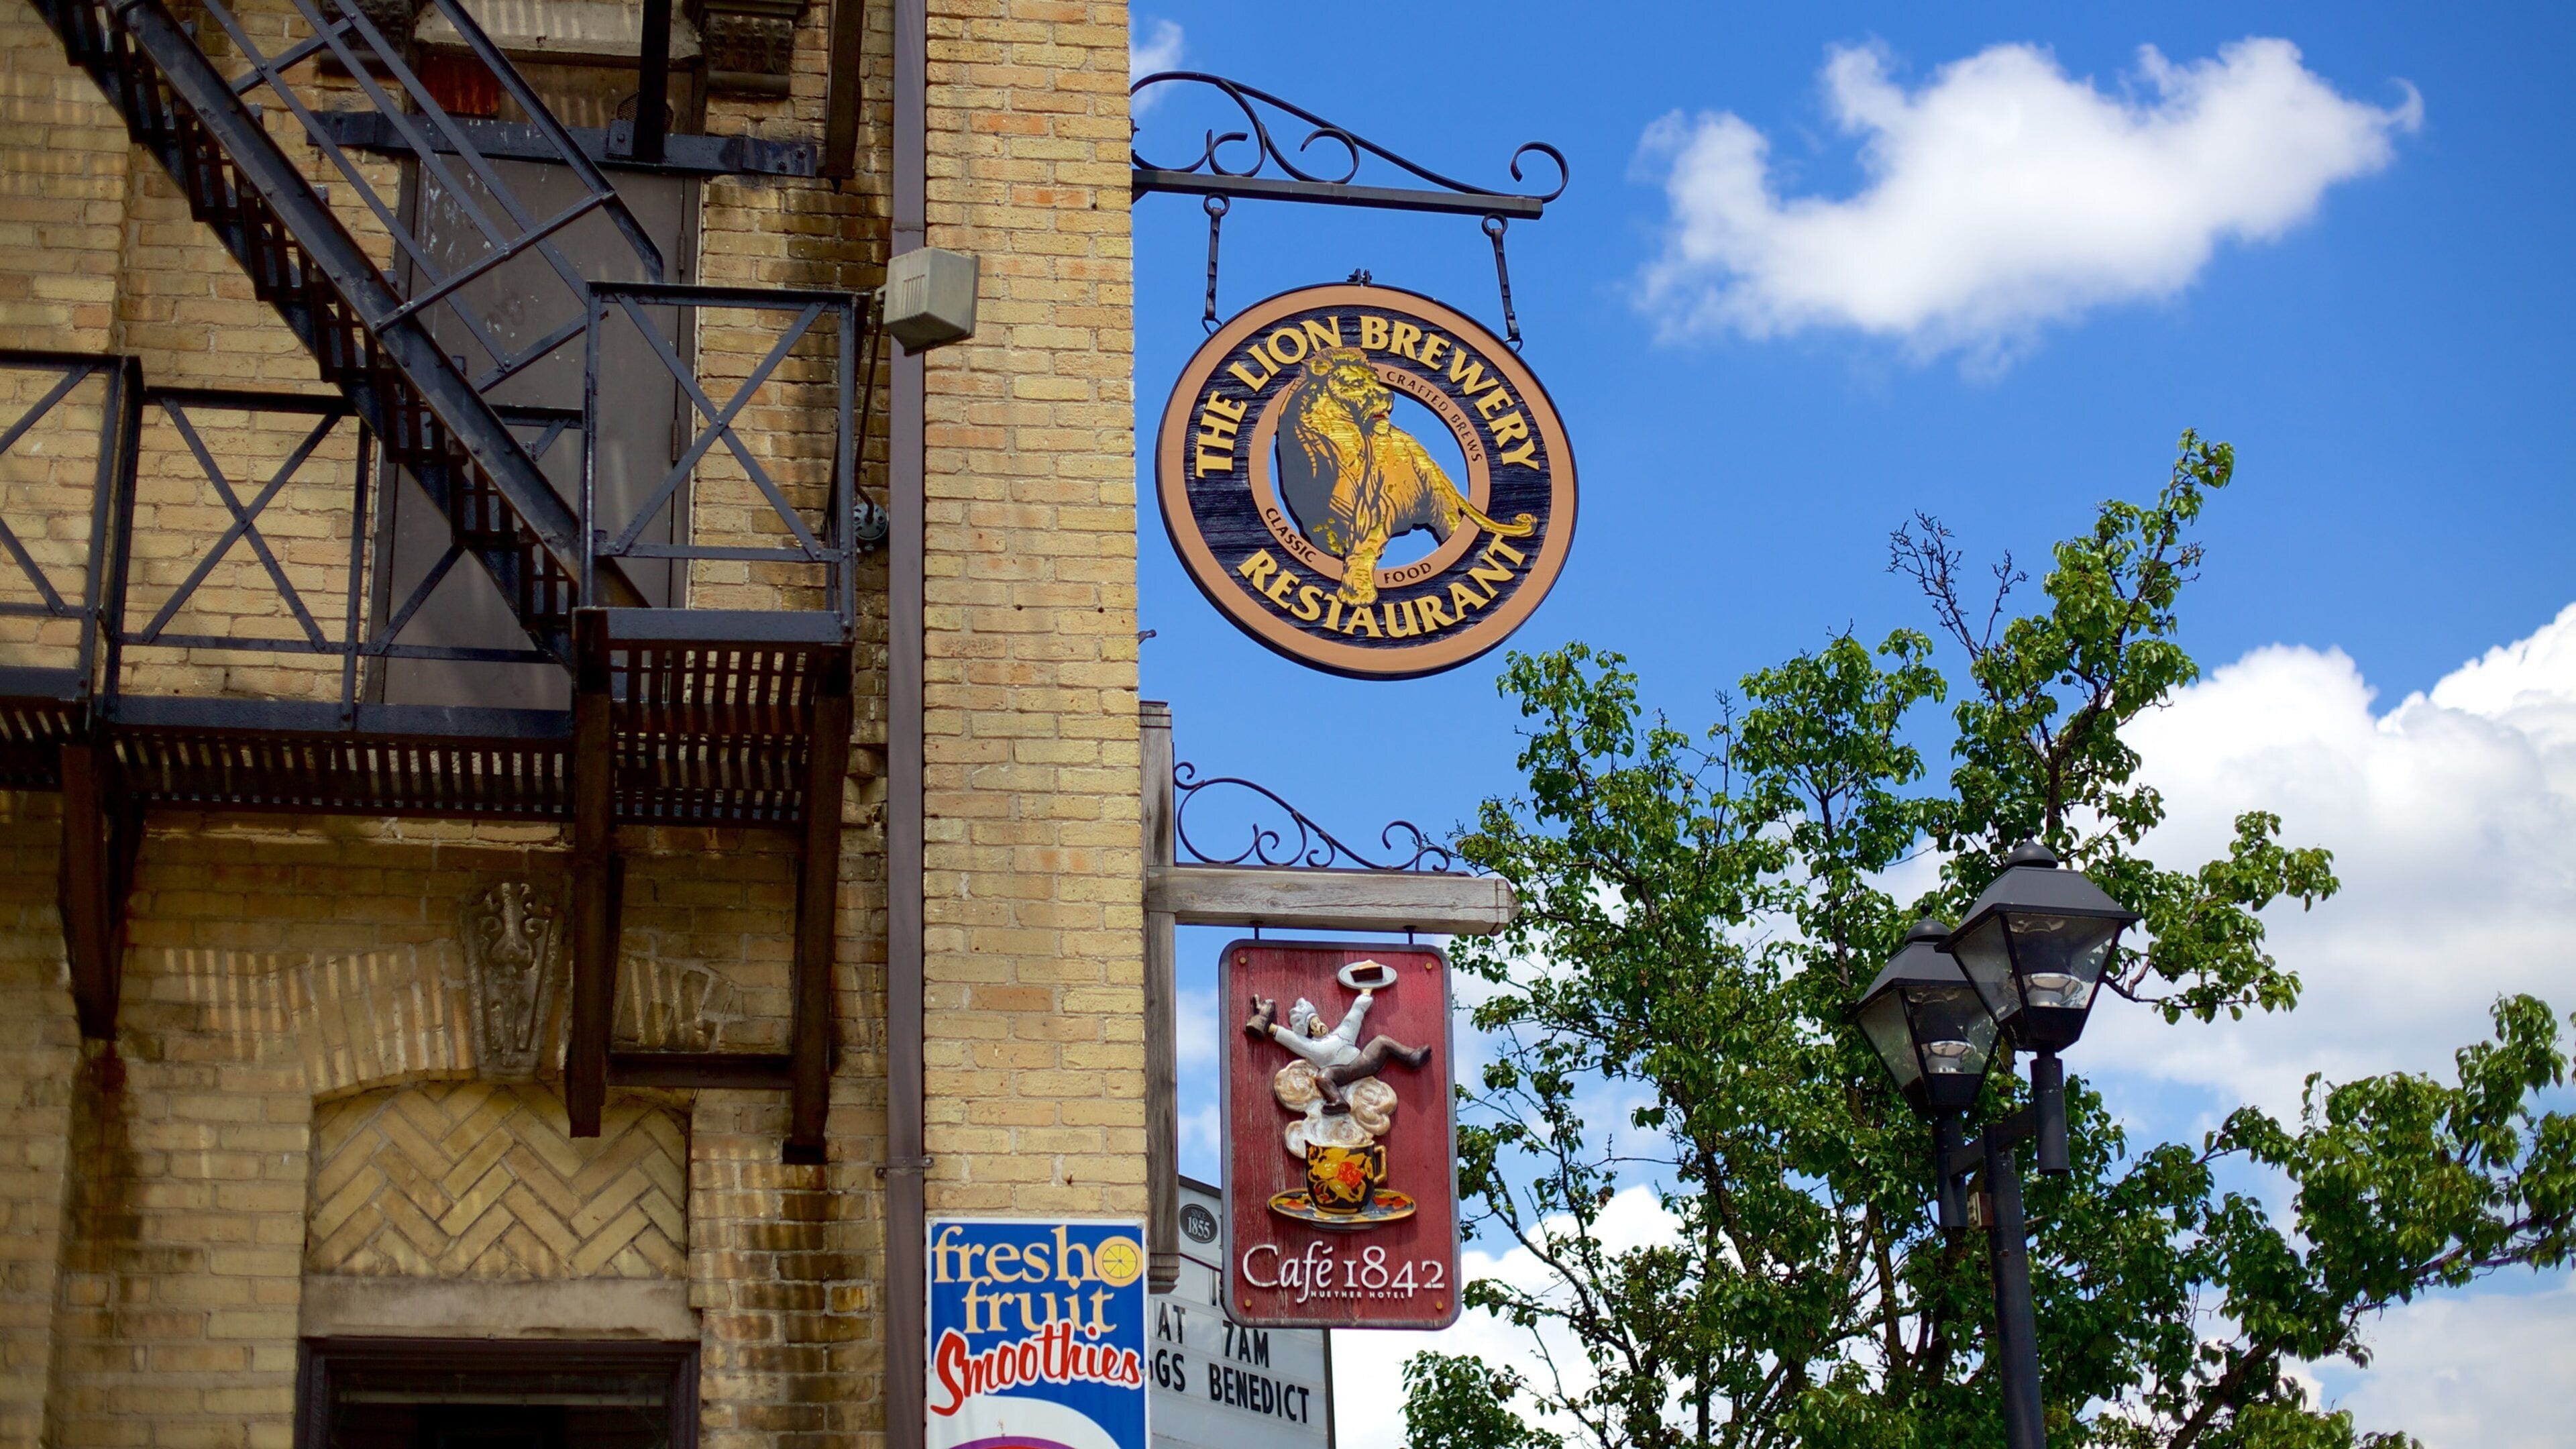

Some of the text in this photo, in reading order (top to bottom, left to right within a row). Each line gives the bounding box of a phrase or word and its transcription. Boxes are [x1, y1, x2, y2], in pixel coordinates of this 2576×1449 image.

[1196, 315, 1540, 479] THE LION BREWERY
[1386, 371, 1483, 462] CRAFTED BREWS
[1265, 507, 1432, 584] CLASSIC FOOD
[1238, 535, 1526, 639] RESTAURANT
[1188, 1217, 1210, 1239] 1855
[1191, 1209, 1206, 1219] SINCE
[932, 1225, 1100, 1283] fresh
[1243, 1241, 1334, 1303] Café
[1344, 1246, 1445, 1297] 1842
[961, 1276, 1118, 1334] fruit
[1310, 1291, 1406, 1299] HUETHER HOTEL
[1158, 1302, 1270, 1368] AT 7AM
[930, 1322, 1141, 1416] Smoothies
[1149, 1348, 1309, 1424] GS BENEDICT
